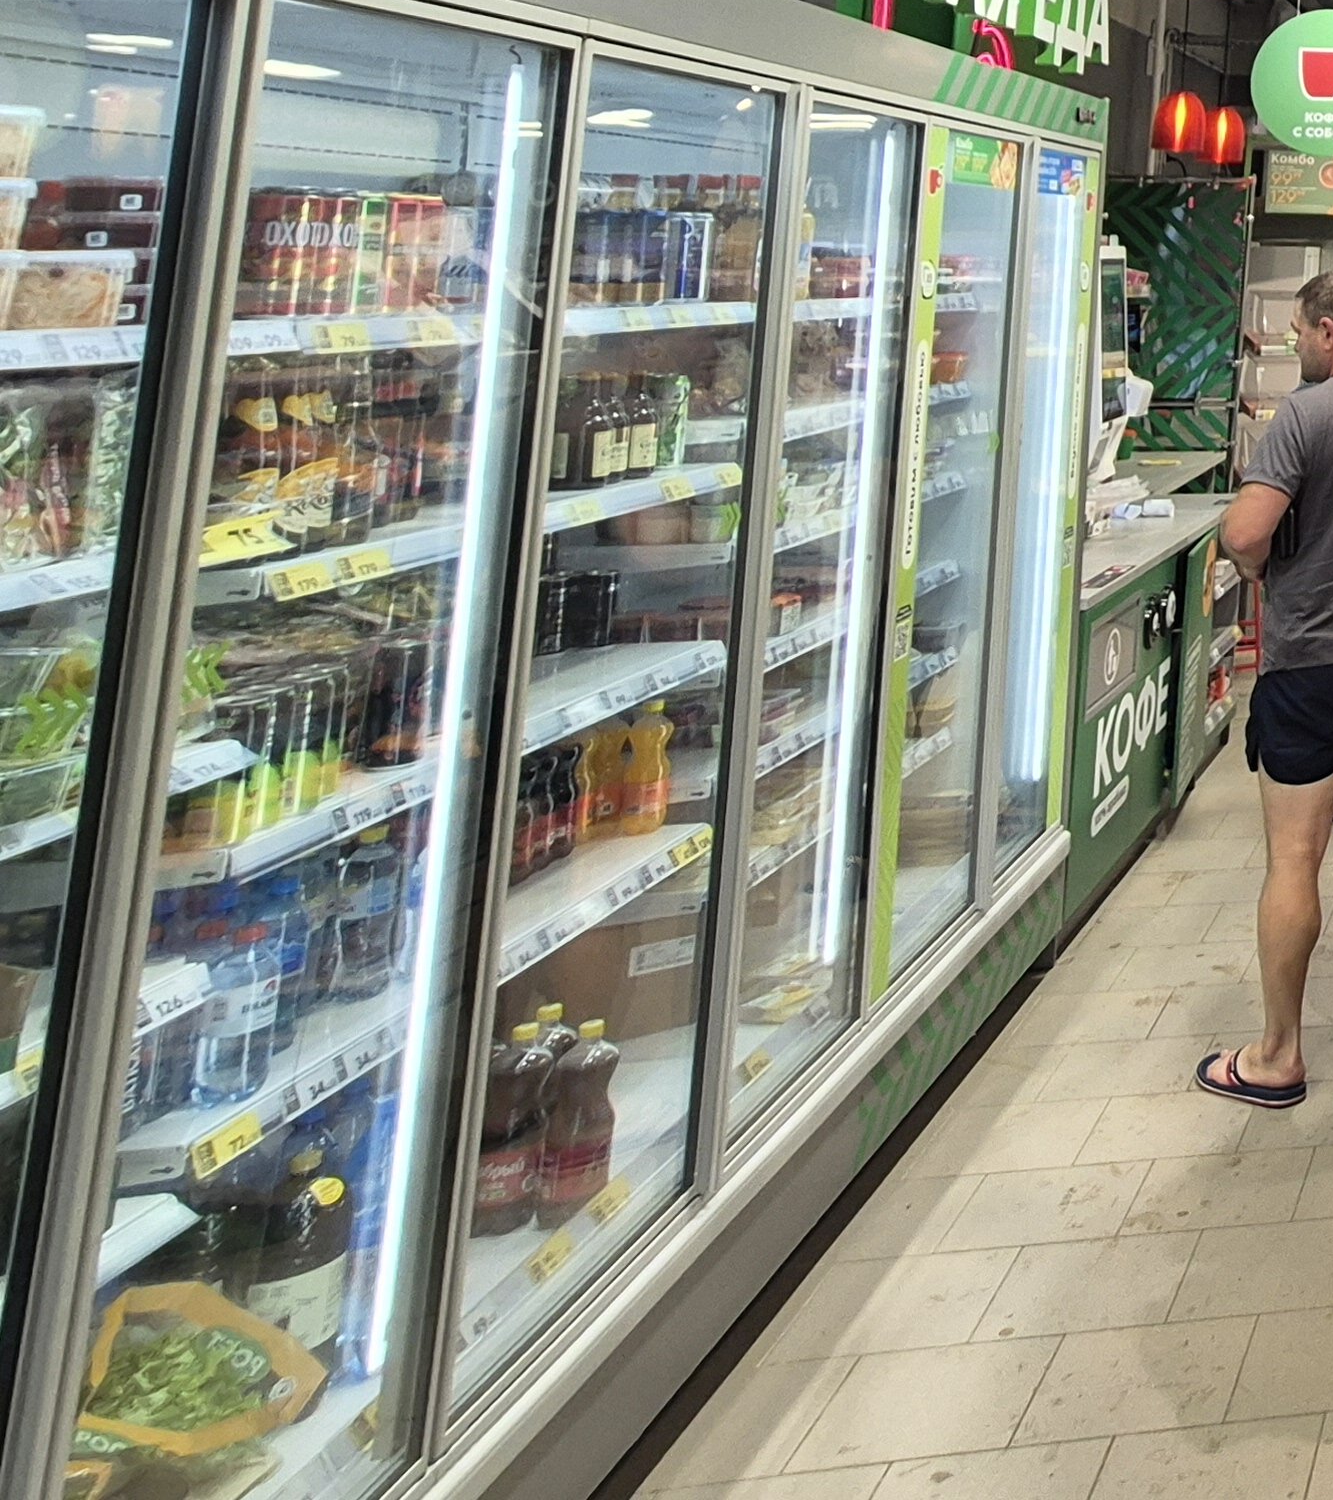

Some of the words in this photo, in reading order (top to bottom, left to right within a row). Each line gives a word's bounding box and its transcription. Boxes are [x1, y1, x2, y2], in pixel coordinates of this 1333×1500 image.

[1292, 128, 1302, 138] С
[1270, 153, 1315, 166] Комбо
[1093, 656, 1171, 800] КОФЕ
